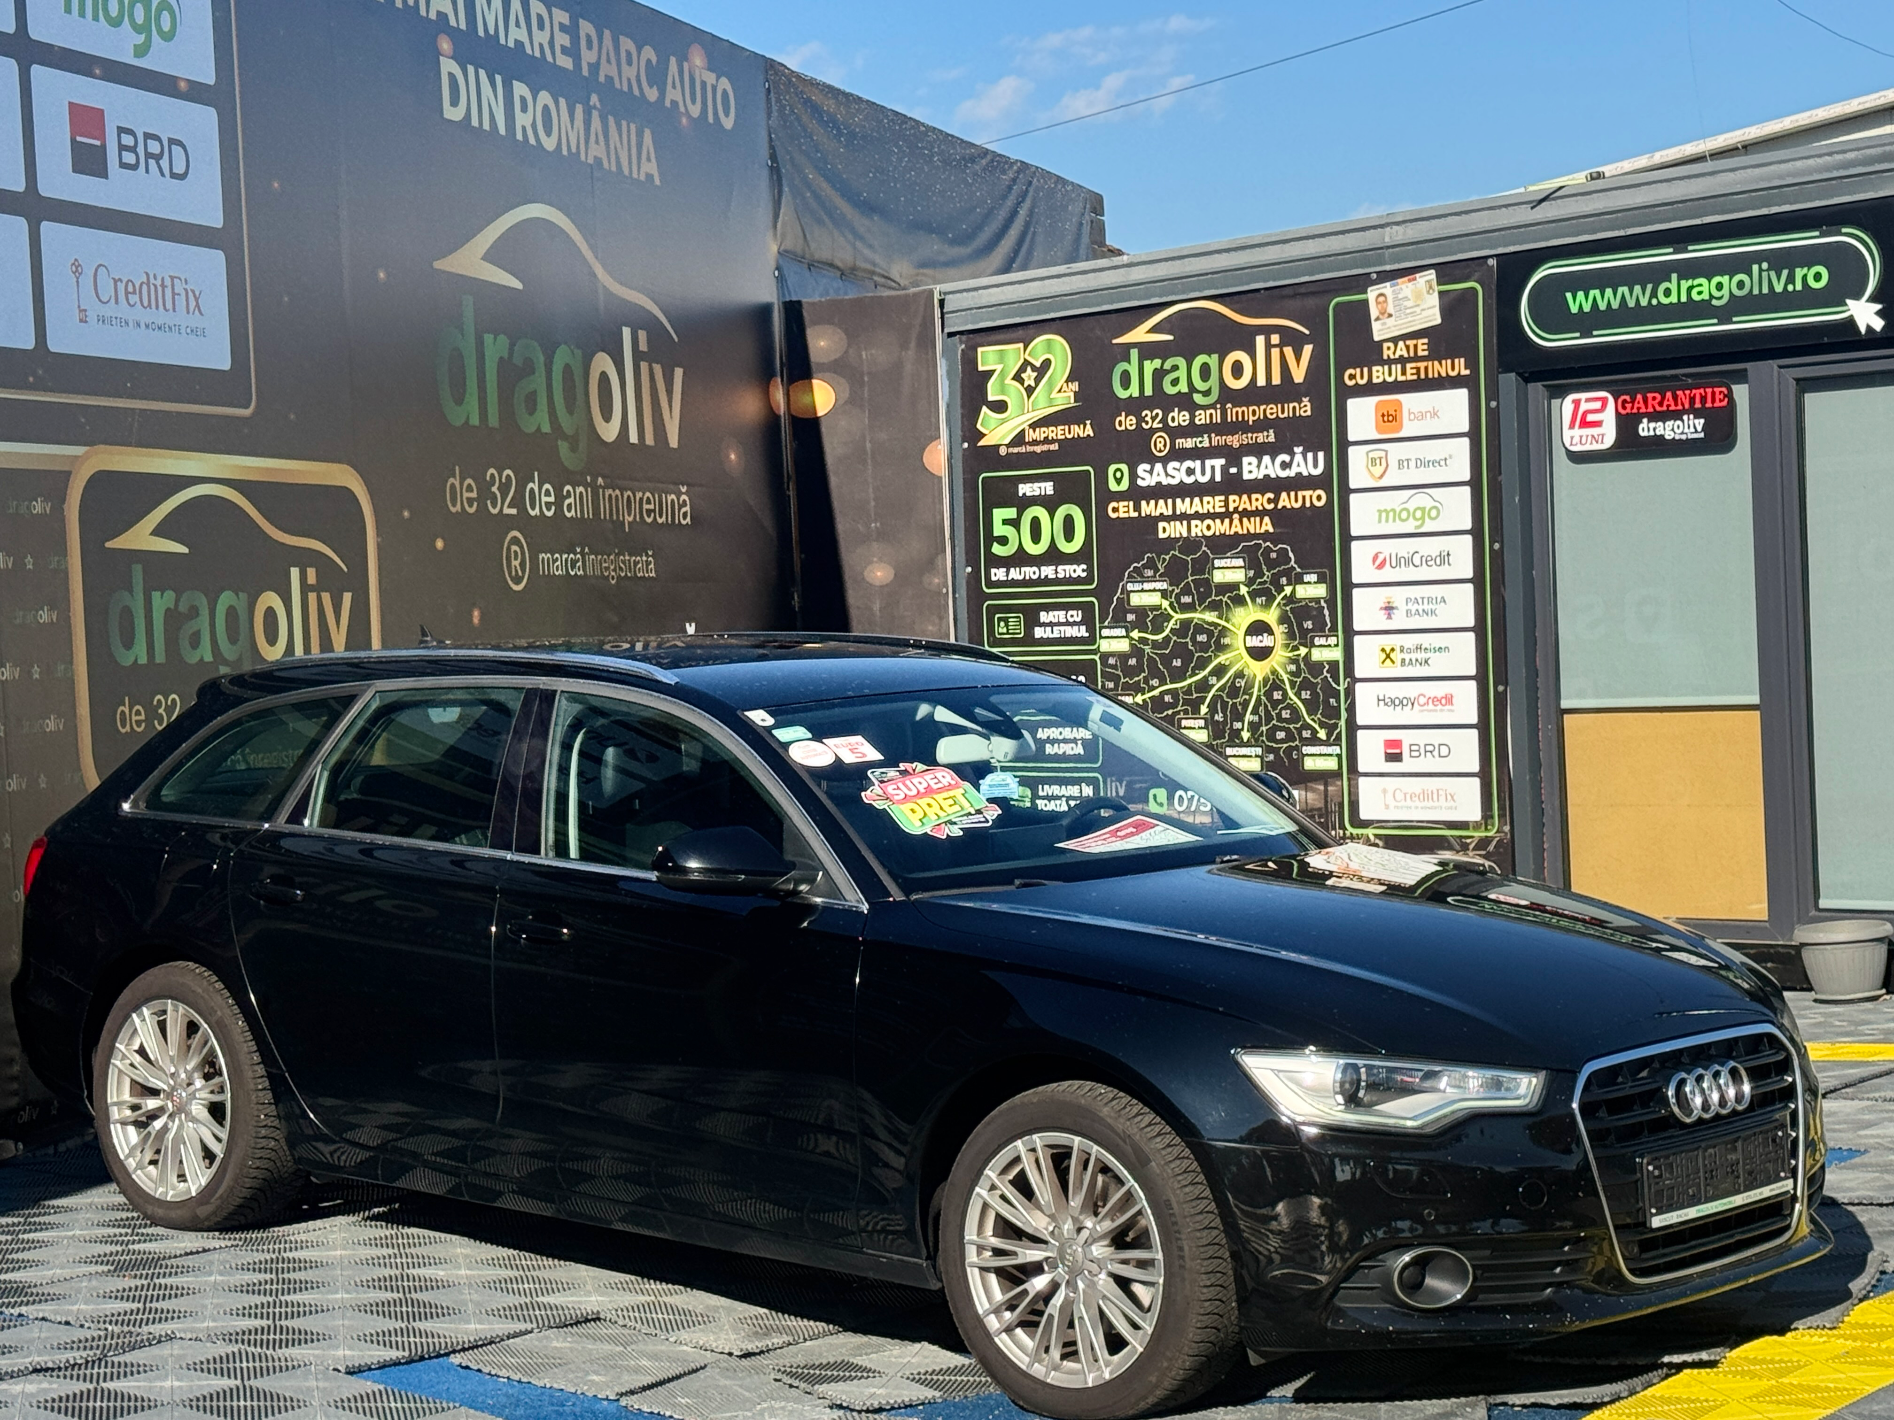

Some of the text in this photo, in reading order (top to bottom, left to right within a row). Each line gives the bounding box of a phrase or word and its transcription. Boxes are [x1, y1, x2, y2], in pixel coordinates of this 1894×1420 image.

[474, 0, 574, 71] MARE
[579, 18, 659, 103] PARC
[665, 55, 735, 131] AUTO
[439, 56, 661, 186] DIN ROMÂNIA
[116, 125, 191, 181] BRD
[93, 263, 204, 317] CreditFix
[1565, 262, 1829, 314] www.dragoliv.ro
[96, 314, 130, 327] PRIETEN
[133, 318, 142, 329] IN
[144, 320, 182, 335] MOMENTE
[1382, 338, 1429, 360] RATE
[1112, 334, 1314, 405] dragoliv
[1344, 358, 1470, 386] CU BULETINUL
[437, 294, 684, 471] dragoliv
[976, 334, 1074, 435] 32
[1060, 381, 1079, 393] ANI
[1617, 386, 1729, 415] GARANTIE
[1115, 397, 1312, 430] de 32 de ani împreună
[1380, 407, 1441, 424] tbi bank
[1568, 396, 1609, 430] 12
[1024, 420, 1094, 442] ÎMPREUNĂ
[1638, 414, 1705, 439] dragoliv
[1176, 434, 1210, 449] marcă
[1211, 429, 1276, 448] înregistrată
[1569, 433, 1606, 447] LUNI
[1136, 458, 1225, 487] SASCUT
[1242, 446, 1325, 480] BACĂU
[1370, 456, 1383, 467] BT
[1397, 459, 1412, 471] BT
[446, 465, 692, 532] de 32 de ani împreună
[1018, 482, 1055, 497] PESTE
[1107, 489, 1327, 518] CEL MAI MARE PARC AUTO
[1157, 513, 1274, 539] DIN ROMÂNIA
[1376, 503, 1441, 531] mogo
[991, 503, 1086, 557] 500
[539, 547, 583, 576] marcă
[585, 546, 656, 584] înregistrată
[1389, 549, 1452, 569] UniCredit
[990, 564, 1088, 581] DE AUTO PE STOC
[1256, 597, 1266, 605] NT
[1406, 596, 1447, 606] PATRIA
[108, 563, 353, 676] dragoliv
[1039, 610, 1082, 624] RATE CU
[1406, 608, 1438, 618] BANK
[1034, 625, 1089, 639] BULETINUL
[1303, 621, 1313, 629] VS
[1245, 633, 1275, 647] BACĂU
[1400, 643, 1450, 654] Raiffeisen
[1400, 657, 1431, 667] BANK
[1377, 693, 1454, 711] HappyCredit
[116, 694, 181, 733] de 32
[1036, 727, 1093, 739] APROBARE
[849, 747, 867, 759] 5
[1045, 741, 1084, 755] RAPIDĂ
[1409, 743, 1451, 758] BRD
[887, 770, 956, 800] SUPER
[1038, 782, 1093, 797] LIVRARE ÎN
[1392, 788, 1457, 803] CreditFix
[900, 787, 976, 827] PREȚ
[1035, 797, 1068, 812] TOATĂ
